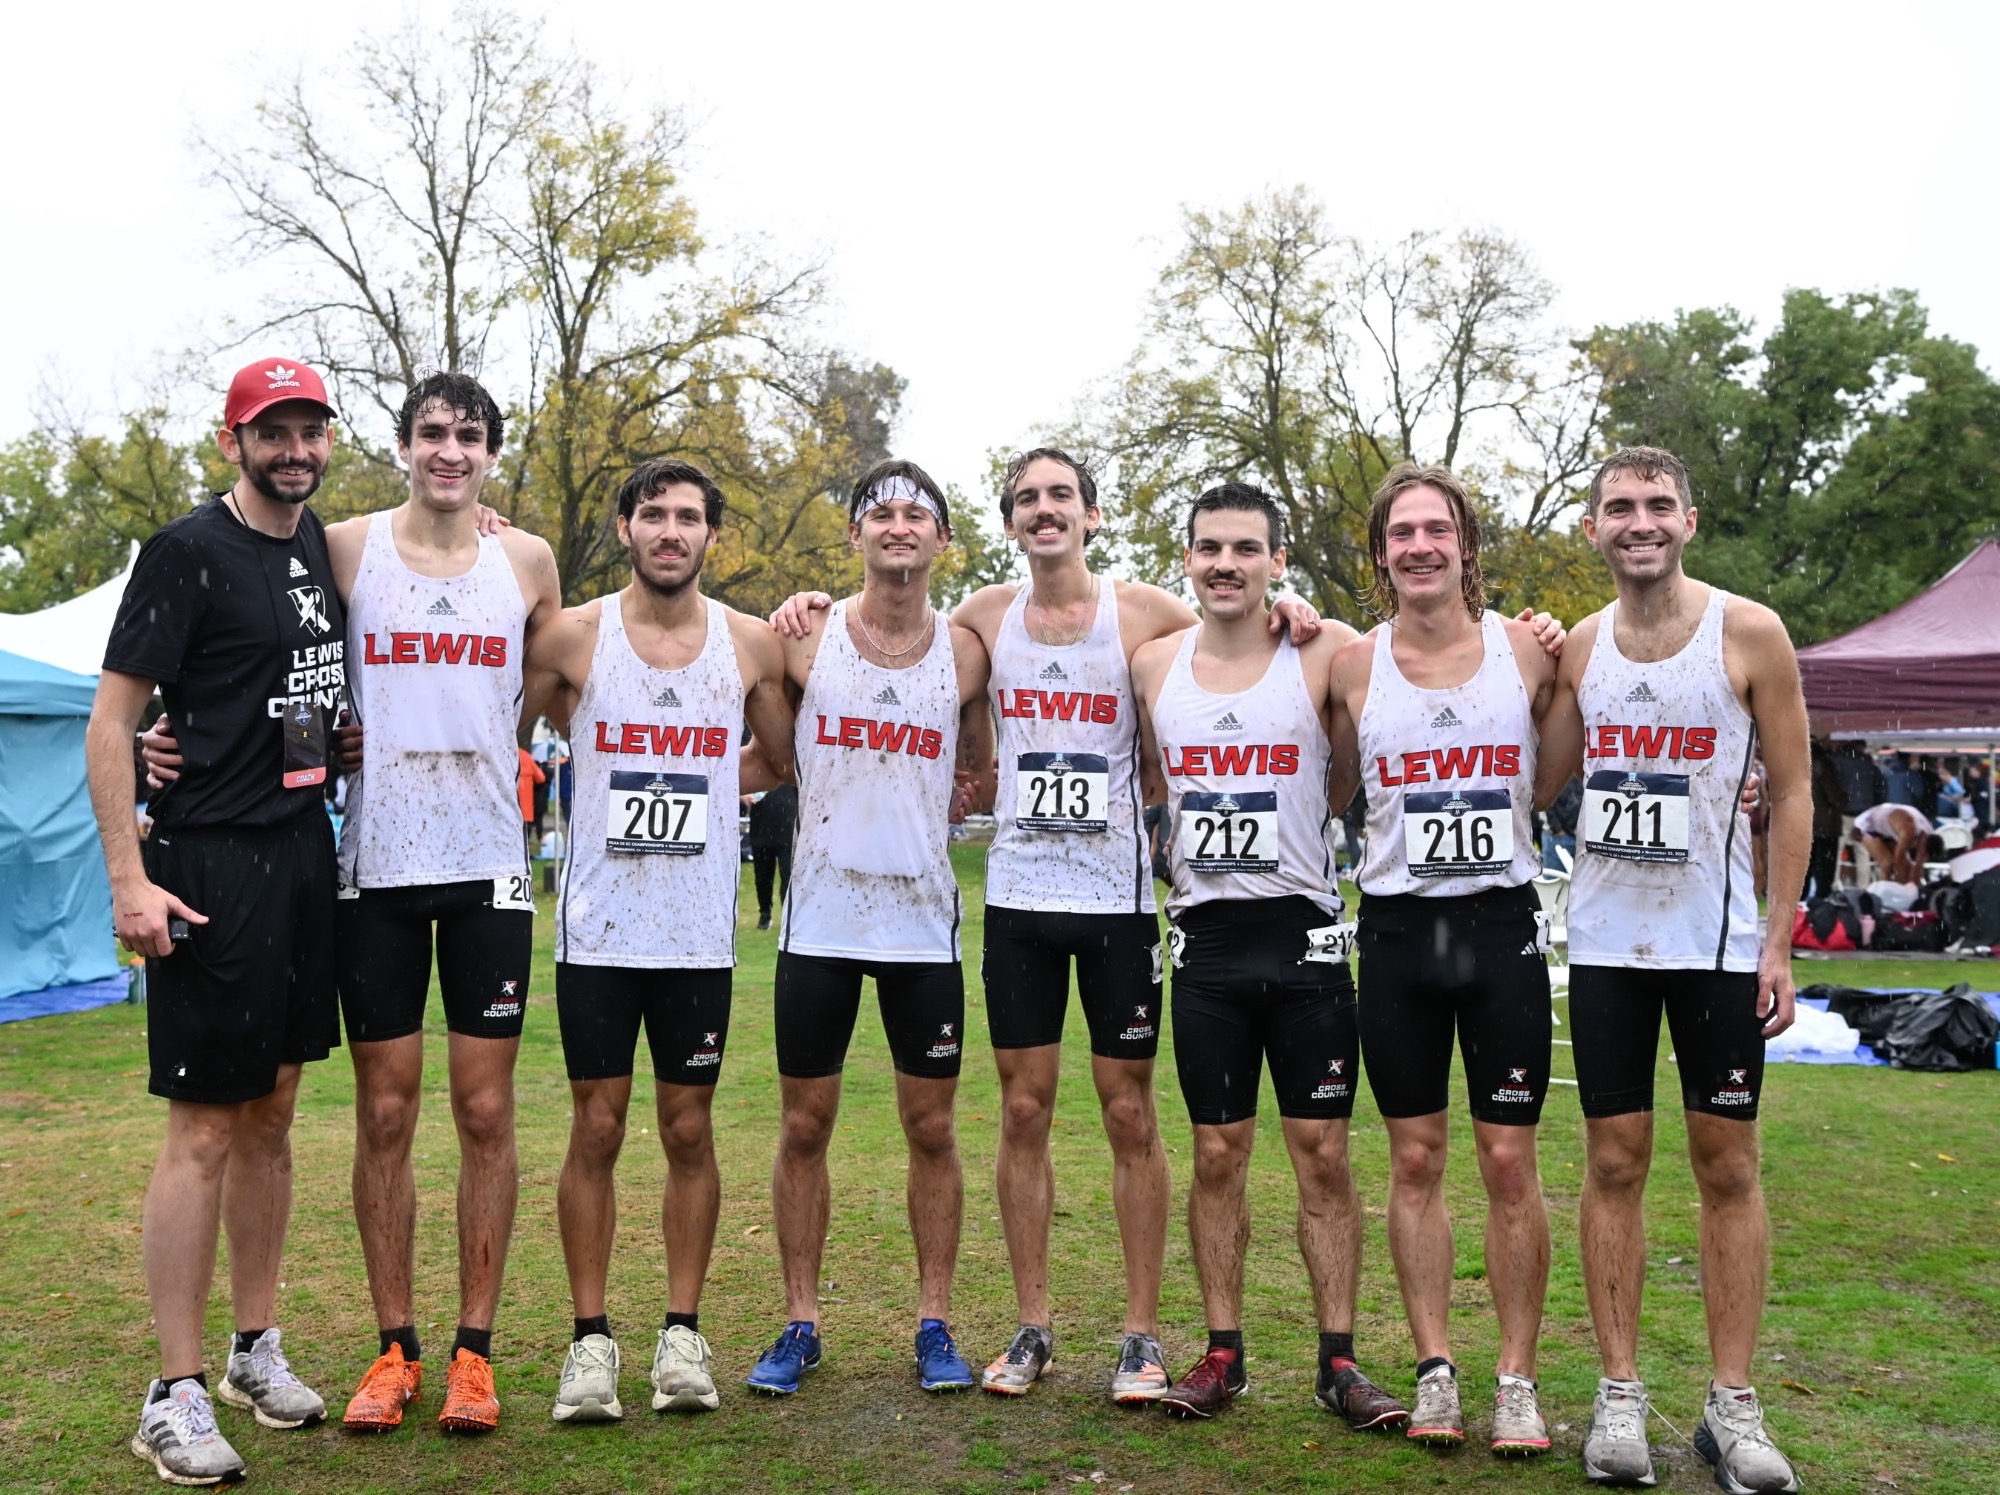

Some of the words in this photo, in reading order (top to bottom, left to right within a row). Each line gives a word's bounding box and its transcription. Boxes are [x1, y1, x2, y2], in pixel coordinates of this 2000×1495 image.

[268, 380, 301, 389] adidas
[289, 568, 309, 578] adidas
[426, 608, 459, 616] adidas
[364, 632, 507, 668] LEWIS
[292, 640, 344, 670] LEWIS
[1039, 672, 1068, 680] adidas
[872, 697, 901, 706] adidas
[1625, 694, 1656, 702] adidas
[653, 699, 683, 708] adidas
[997, 688, 1118, 725] LEWIS
[1213, 722, 1243, 731] adidas
[1430, 719, 1463, 728] adidas
[595, 721, 729, 757] LEWIS
[816, 715, 943, 760] LEWIS
[1586, 725, 1717, 760] LEWIS
[1162, 744, 1300, 777] LEWIS
[1376, 745, 1520, 787] LEWIS
[296, 773, 315, 783] COACH
[1030, 776, 1090, 819] 213
[624, 796, 692, 841] 207
[1602, 797, 1666, 848] 211
[1195, 816, 1260, 860] 212
[1423, 816, 1494, 863] 216
[510, 875, 535, 904] 20
[491, 1003, 519, 1011] CROSS
[483, 1008, 521, 1018] COUNTRY
[1126, 1025, 1152, 1034] CROSS
[1120, 1030, 1154, 1040] COUNTRY
[932, 1043, 957, 1052] CROSS
[693, 1052, 719, 1060] CROSS
[926, 1048, 959, 1058] COUNTRY
[686, 1057, 720, 1066] COUNTRY
[1318, 1084, 1347, 1092] CROSS
[1498, 1088, 1530, 1097] CROSS
[1311, 1090, 1349, 1099] COUNTRY
[1491, 1094, 1534, 1103] COUNTRY
[1718, 1091, 1750, 1099] CROSS
[1711, 1096, 1753, 1105] COUNTRY
